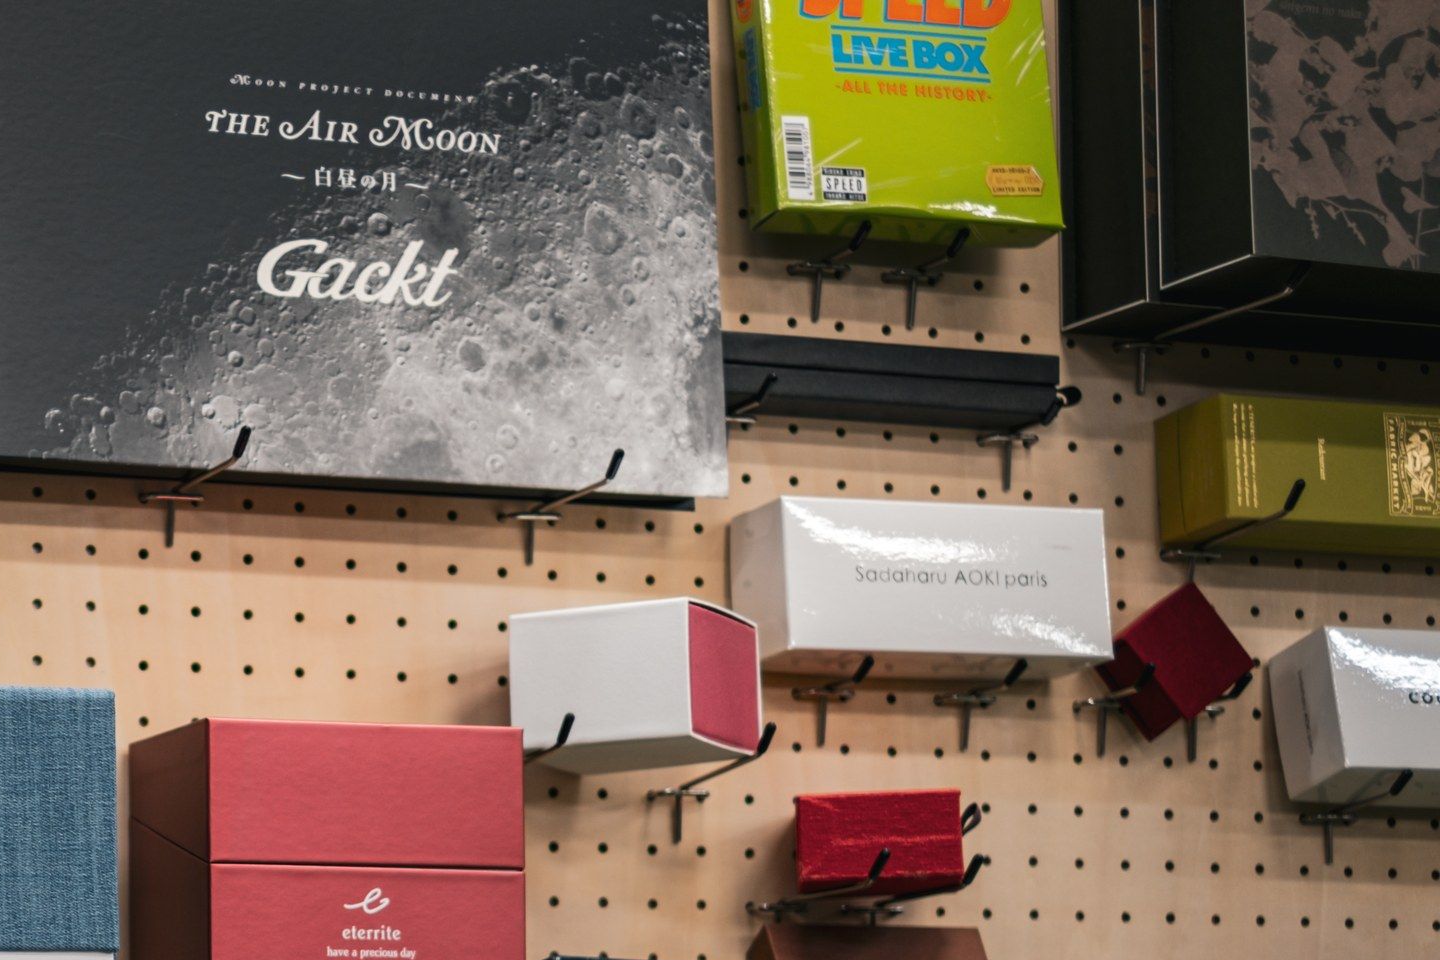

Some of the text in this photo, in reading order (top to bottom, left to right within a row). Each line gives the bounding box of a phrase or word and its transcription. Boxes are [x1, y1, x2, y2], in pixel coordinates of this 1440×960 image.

[831, 34, 989, 75] LIVE BOX
[299, 82, 374, 96] PROJECT
[384, 89, 476, 104] DOCUMENT
[879, 83, 908, 97] THE
[205, 109, 270, 137] THE
[257, 238, 460, 307] Gackt
[855, 566, 1048, 589] Sadaharu AOKI paris
[342, 925, 402, 941] eterrite
[326, 945, 416, 960] have a precious day
